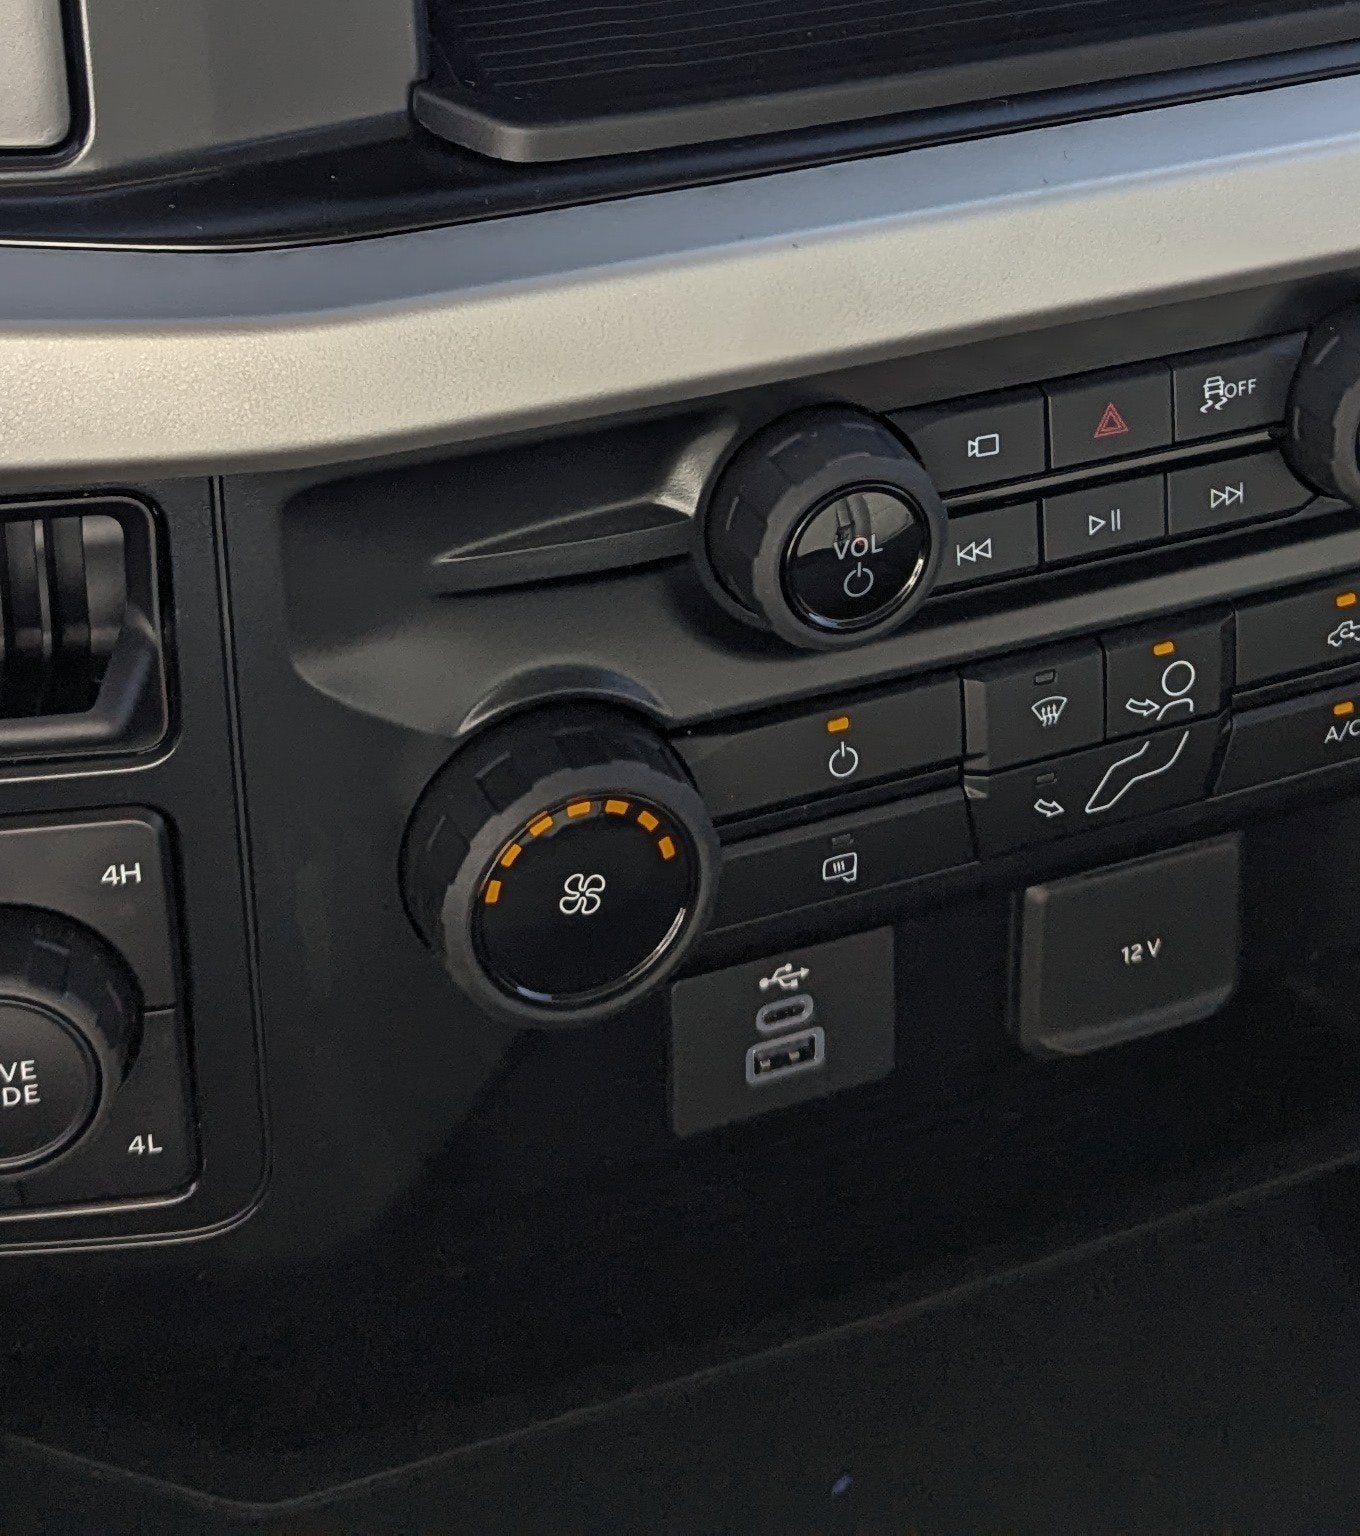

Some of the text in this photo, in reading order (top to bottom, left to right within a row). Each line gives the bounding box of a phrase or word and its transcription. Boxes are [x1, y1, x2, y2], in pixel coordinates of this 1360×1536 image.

[1224, 378, 1257, 399] OFF
[833, 533, 884, 561] VOL
[101, 861, 142, 886] 4H
[1121, 937, 1161, 964] 12 V
[127, 1133, 163, 1155] 4L
